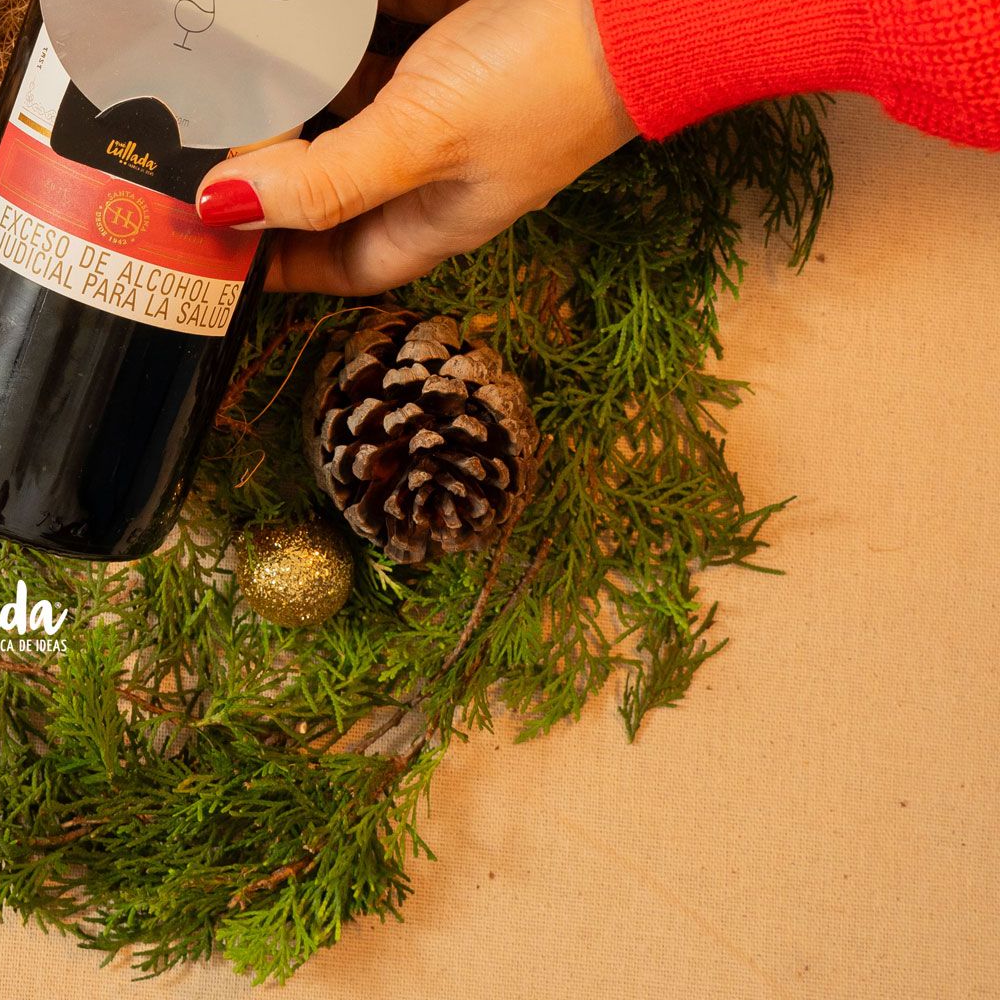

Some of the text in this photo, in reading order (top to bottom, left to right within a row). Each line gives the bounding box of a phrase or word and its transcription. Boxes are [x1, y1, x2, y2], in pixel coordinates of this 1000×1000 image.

[95, 211, 108, 237] DESDE
[107, 190, 150, 232] SANTA HELENA
[0, 204, 71, 259] EXCESO
[79, 245, 112, 276] DE
[117, 260, 210, 305] ALCOHOL
[217, 283, 240, 307] ES
[82, 273, 139, 313] PARA
[144, 294, 170, 321] LA
[176, 297, 232, 330] SALUD
